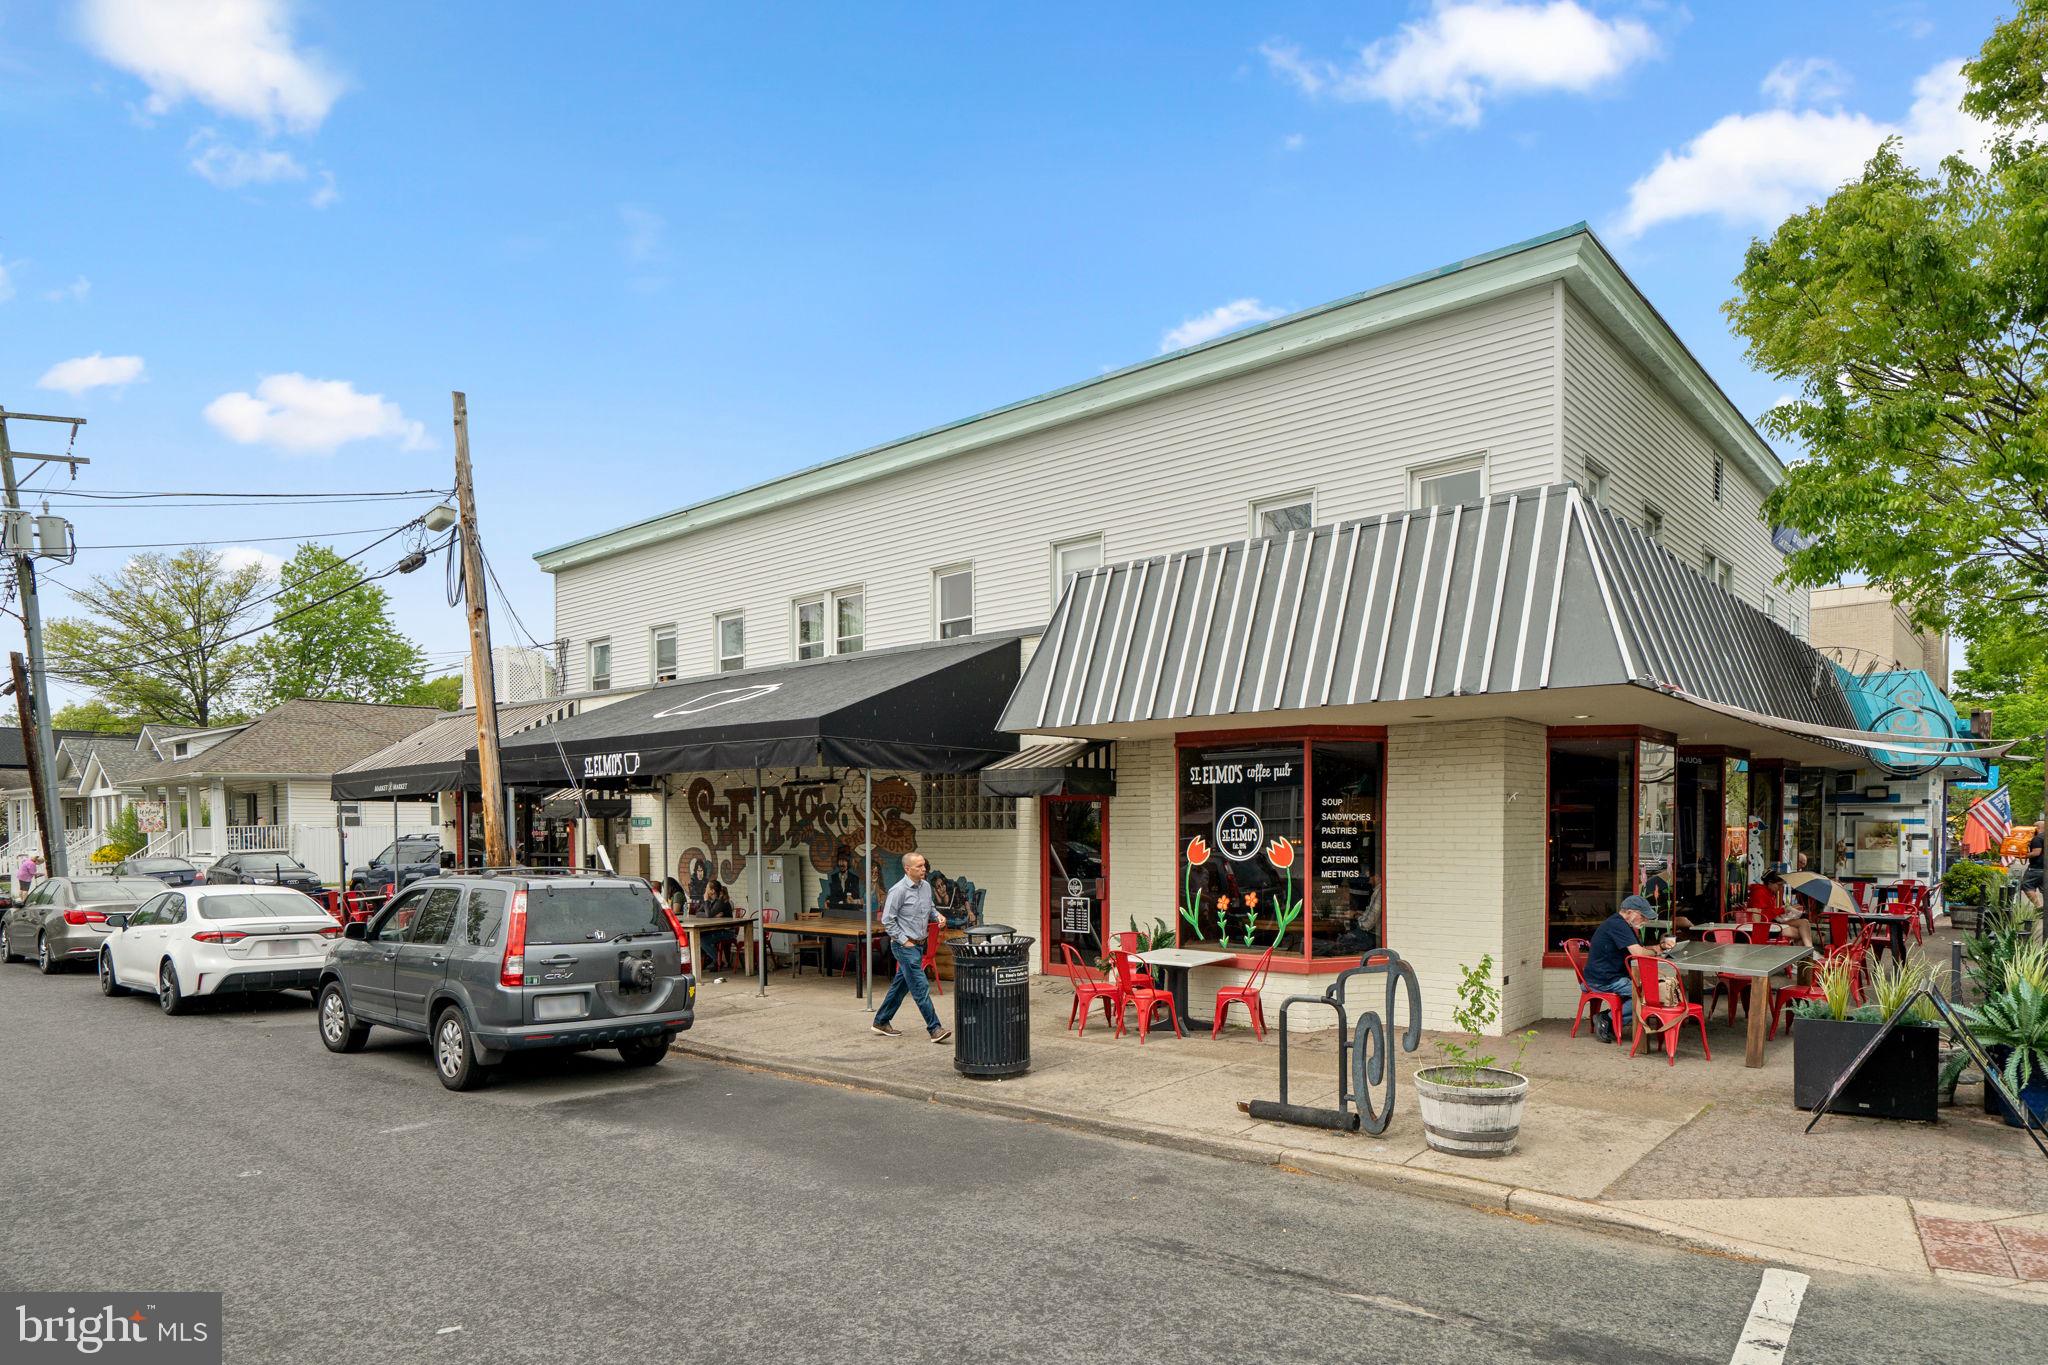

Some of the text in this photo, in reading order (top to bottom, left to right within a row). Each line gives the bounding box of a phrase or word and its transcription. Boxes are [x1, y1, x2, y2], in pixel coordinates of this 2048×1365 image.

[594, 753, 622, 776] ELMO'S
[1190, 762, 1292, 784] ST. ELMO'S coffee pub
[1321, 798, 1343, 806] SOUP
[1321, 813, 1371, 821] SANDWICHES
[1230, 828, 1258, 842] ELMO'S
[1321, 827, 1357, 835] PASTRIES
[1321, 841, 1352, 849] BAGELS
[1321, 856, 1359, 864] CATERING
[1321, 870, 1360, 878] MEETINGS
[544, 972, 574, 981] CR-V
